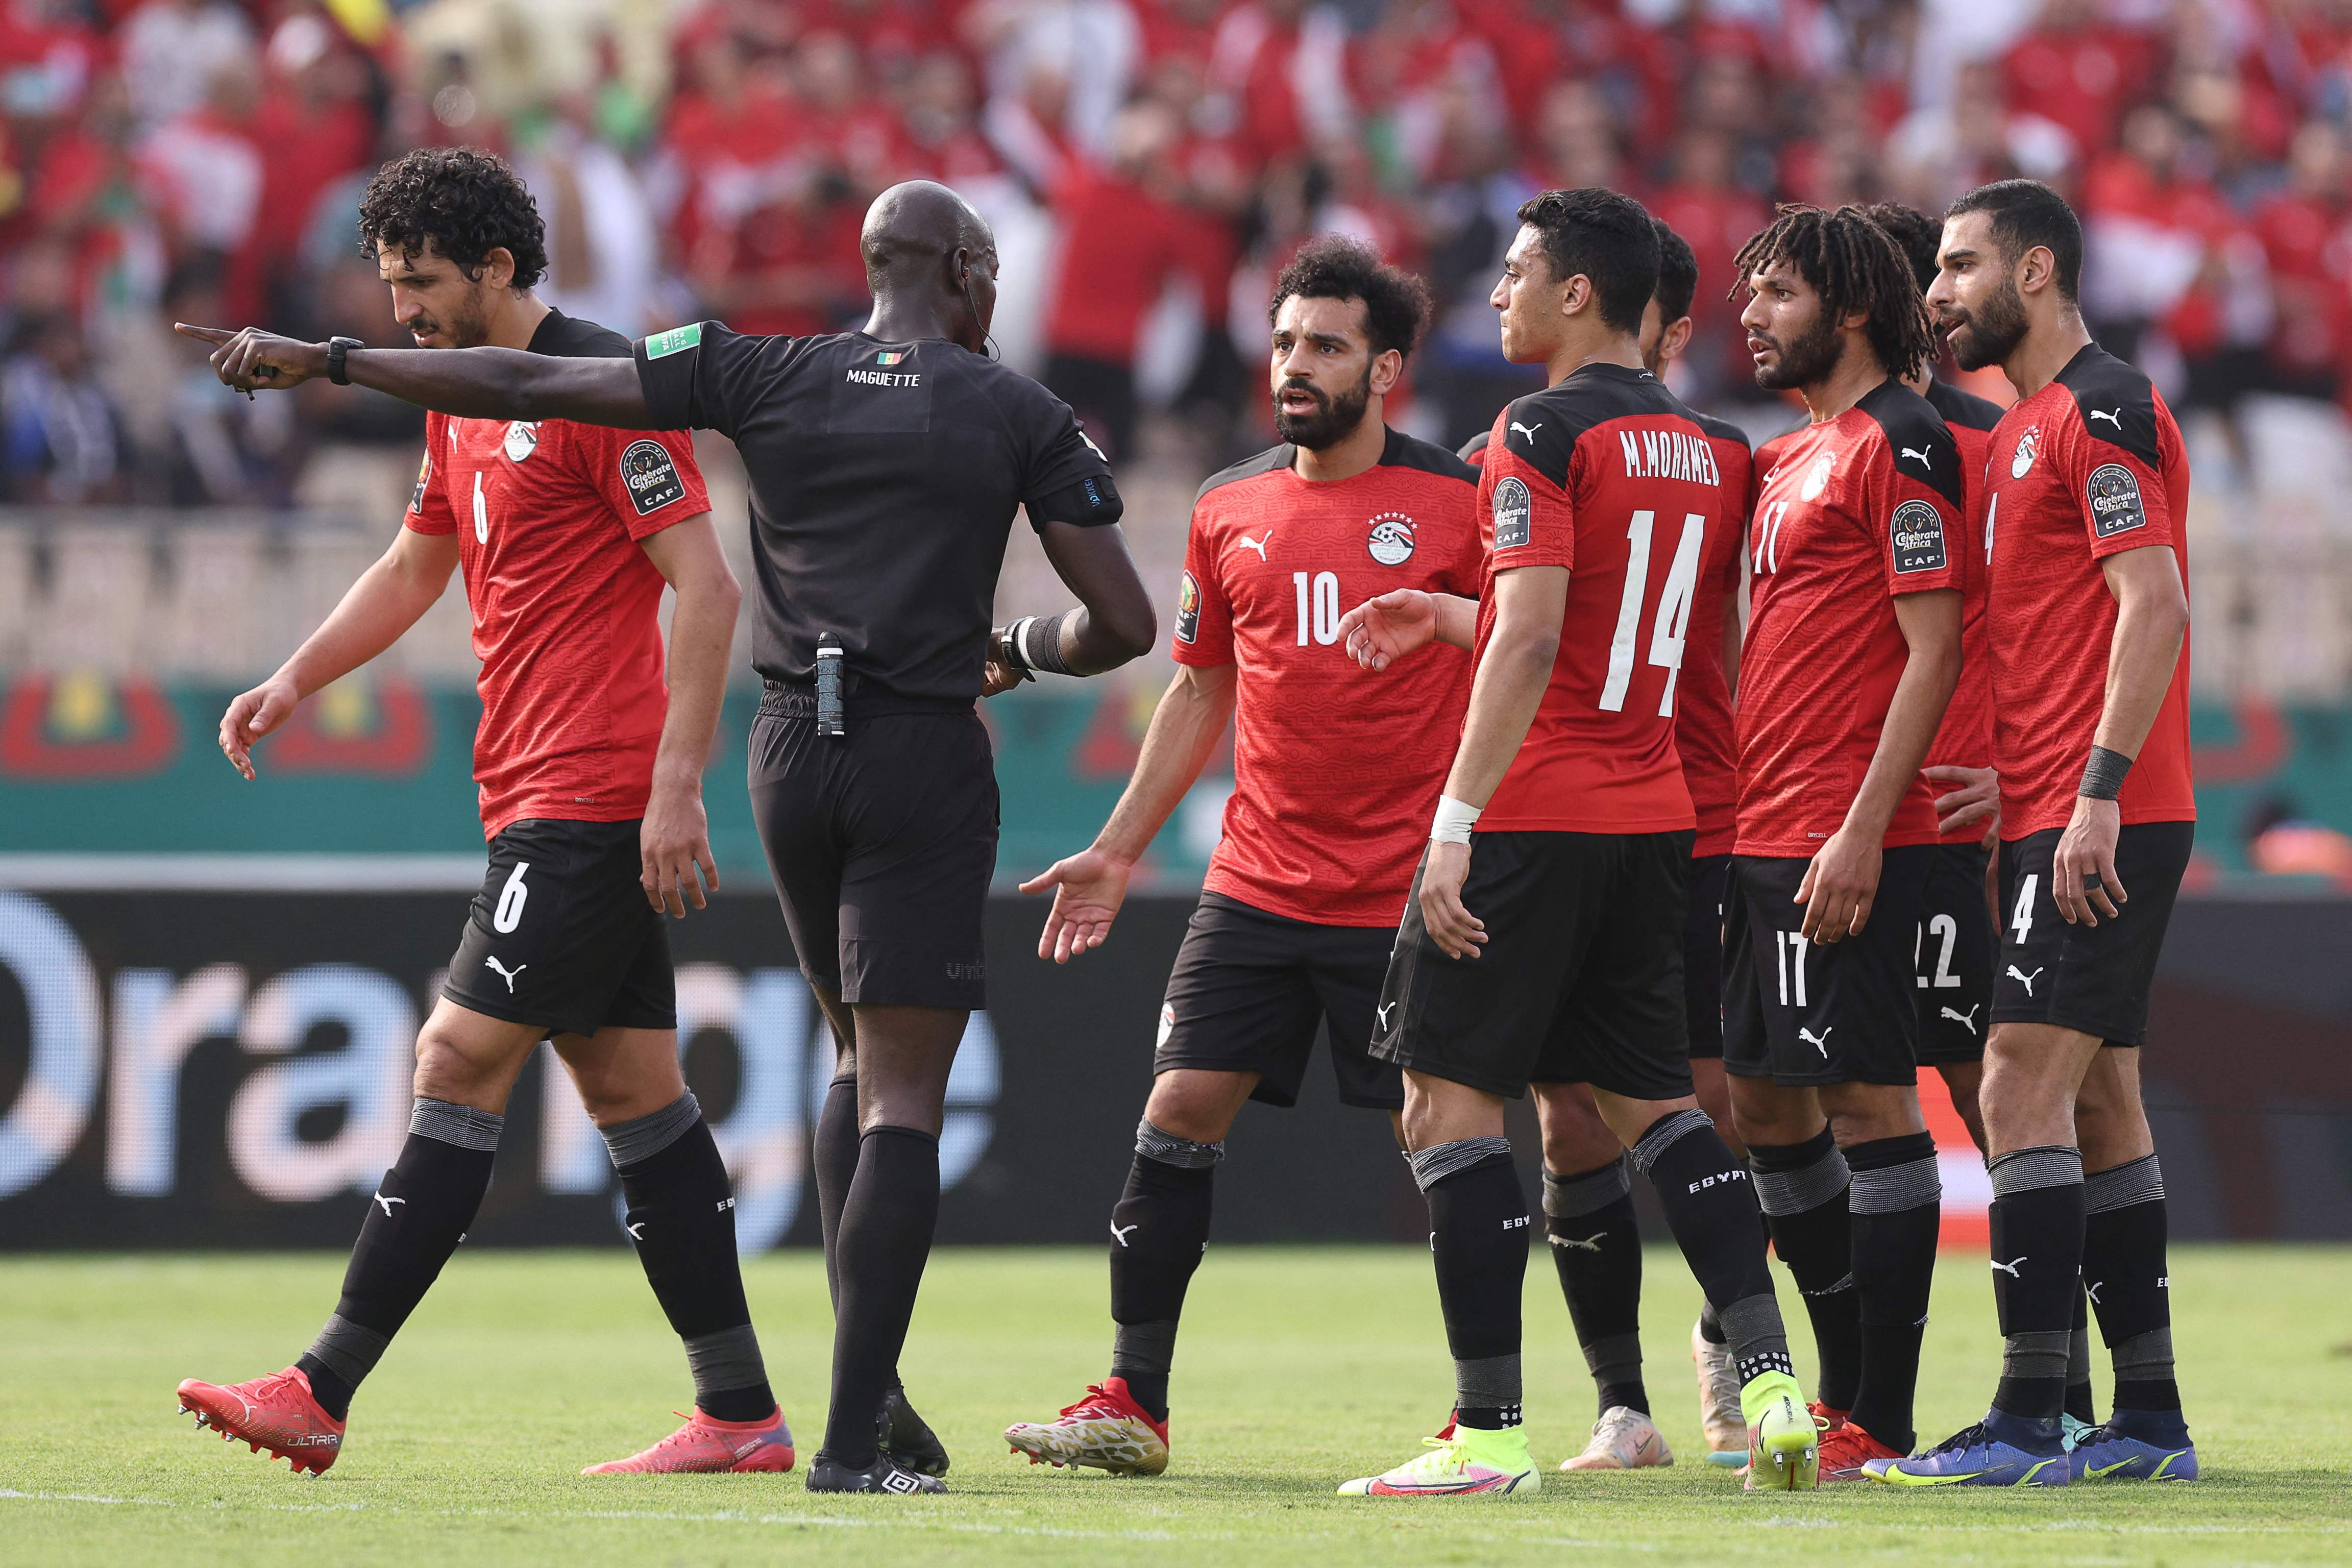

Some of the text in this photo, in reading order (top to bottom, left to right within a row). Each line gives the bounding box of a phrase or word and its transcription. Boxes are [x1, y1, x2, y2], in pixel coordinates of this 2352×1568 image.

[661, 334, 670, 351] FIFA
[846, 369, 921, 387] MAGUETTE
[1619, 430, 1720, 486] M.MOHAMED
[629, 463, 672, 489] Celebrate
[640, 474, 666, 492] Africa
[645, 488, 674, 506] CAF
[2094, 492, 2137, 511] Celebrate
[473, 471, 488, 545] 6
[2102, 501, 2128, 515] Africa
[1984, 492, 1998, 566] 4
[2105, 514, 2134, 529] CAF
[1497, 532, 1520, 544] CAF
[1895, 530, 1940, 547] Celebrate
[1903, 540, 1931, 550] Africa
[1904, 555, 1935, 567] CAF
[1293, 571, 1339, 647] 10
[1598, 510, 1705, 718] 14
[493, 862, 530, 934] 6
[2011, 874, 2038, 944] 4
[1776, 930, 1807, 1007] 17
[1688, 1170, 1747, 1194] EGYPT
[1782, 1395, 1794, 1426] MERCURIAL
[287, 1434, 338, 1447] ULTRA
